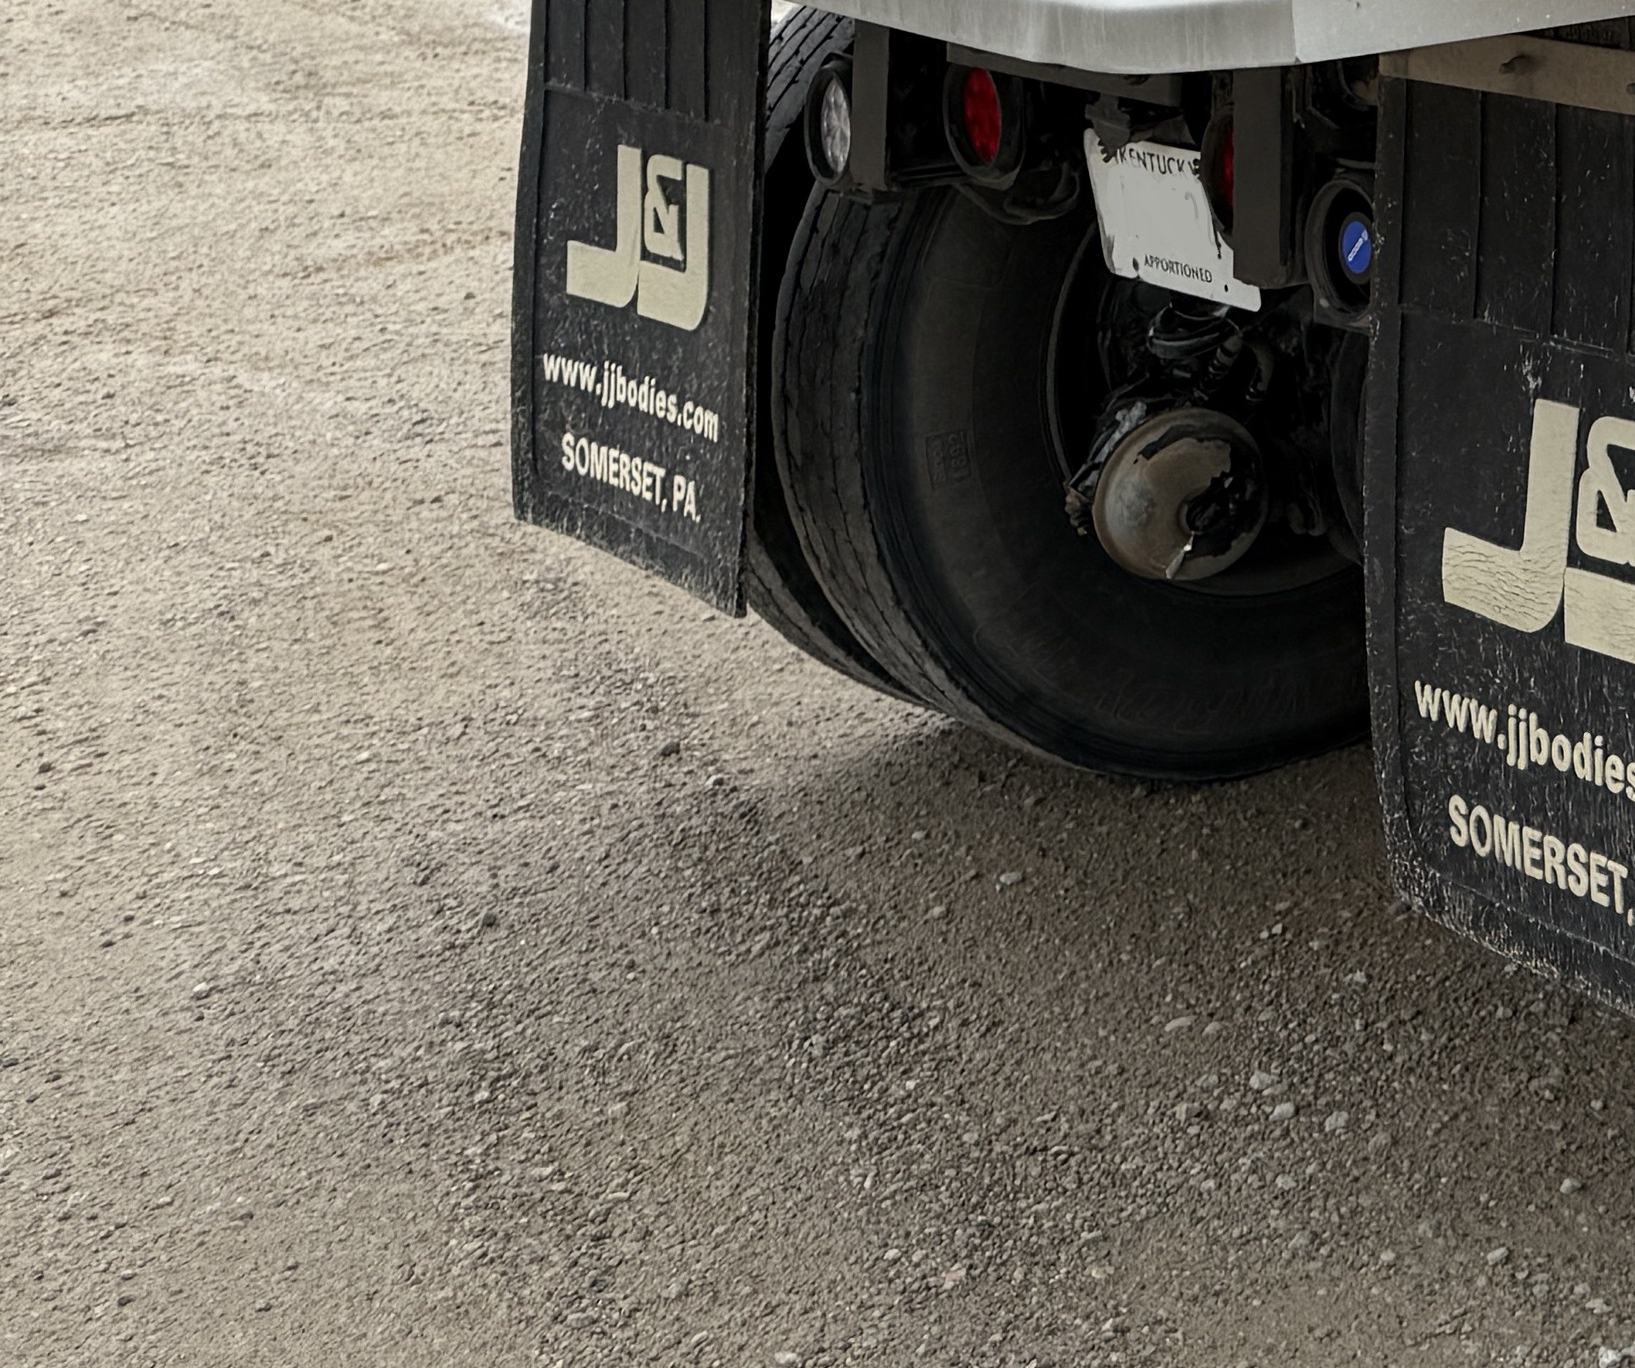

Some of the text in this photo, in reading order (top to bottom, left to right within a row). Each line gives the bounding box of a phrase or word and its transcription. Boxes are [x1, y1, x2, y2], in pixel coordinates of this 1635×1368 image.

[566, 143, 709, 331] J&J
[1144, 254, 1213, 284] APPORTIONED
[543, 352, 718, 443] www.jjbodies.com
[561, 431, 702, 523] SOMERSET, PA.
[1447, 794, 1635, 927] SOMERSET,
